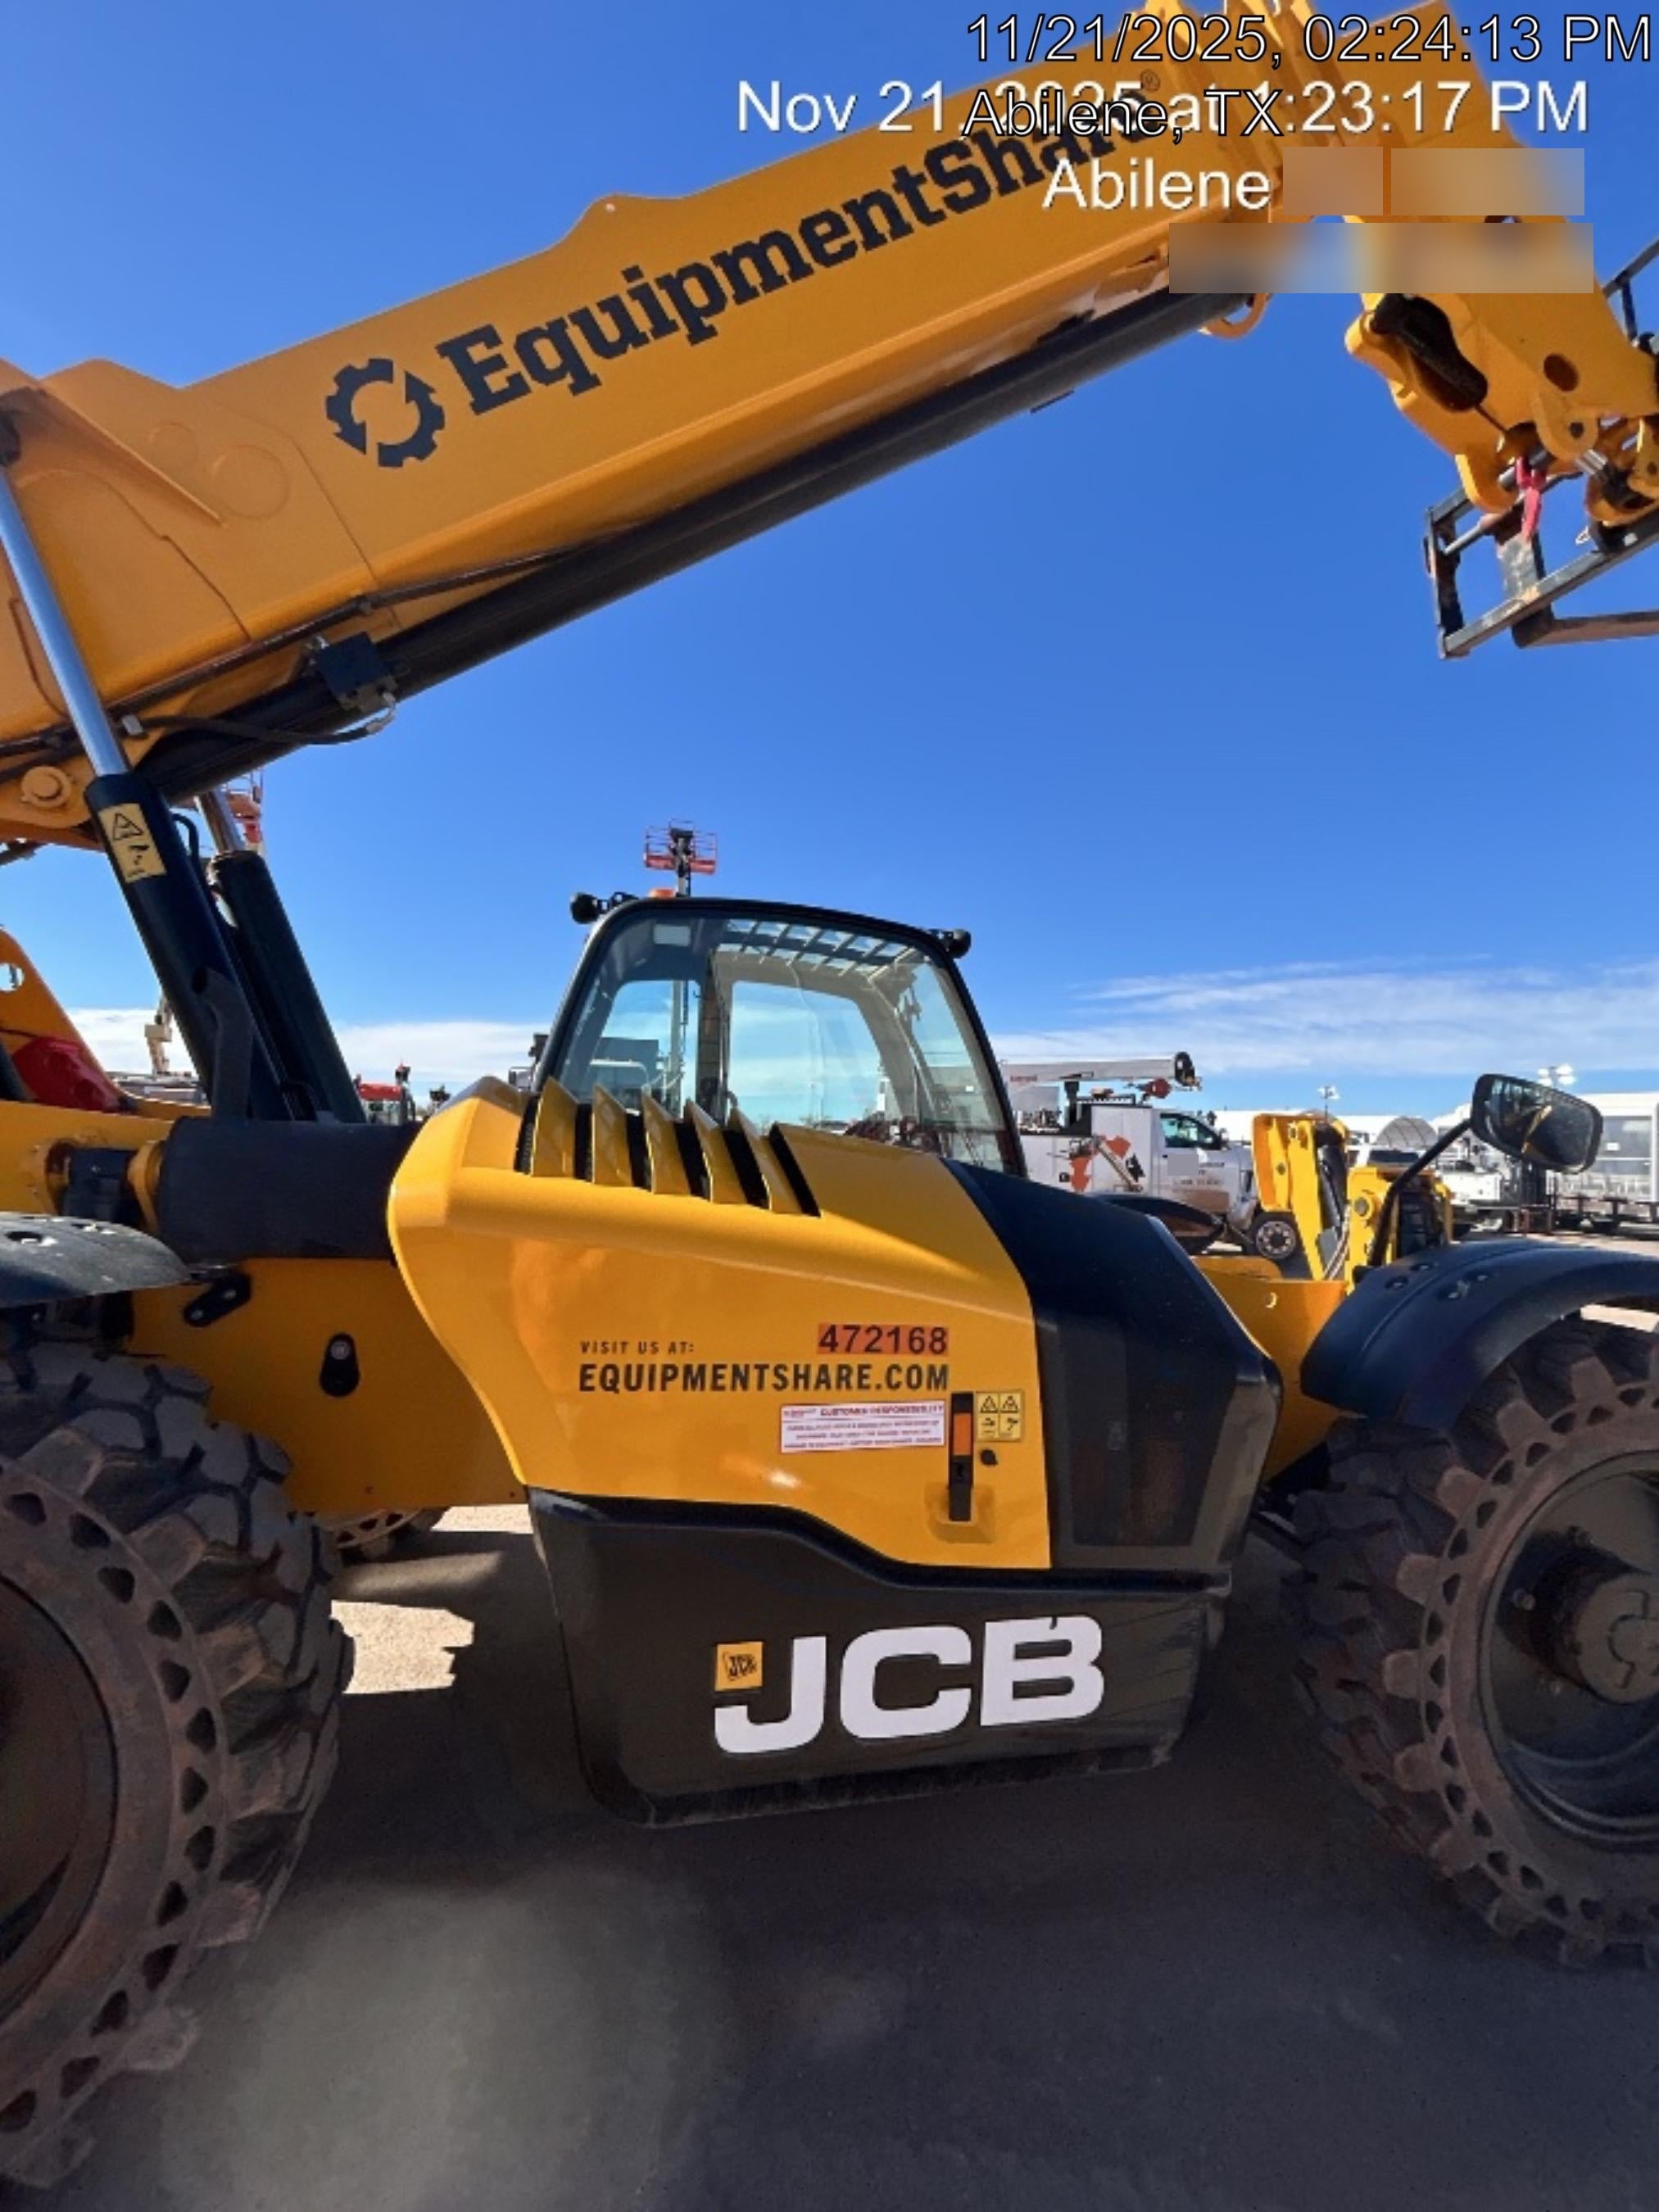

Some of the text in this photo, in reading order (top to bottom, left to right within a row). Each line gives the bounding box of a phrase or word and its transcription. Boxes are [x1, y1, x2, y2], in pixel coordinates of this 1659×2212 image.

[437, 92, 1149, 415] EquipmentShare
[580, 1341, 695, 1355] VISIT US AT:
[818, 1324, 948, 1355] 472168
[578, 1363, 949, 1394] EQUIPMENTSHARE.COM
[714, 1615, 1104, 1754] JCB
